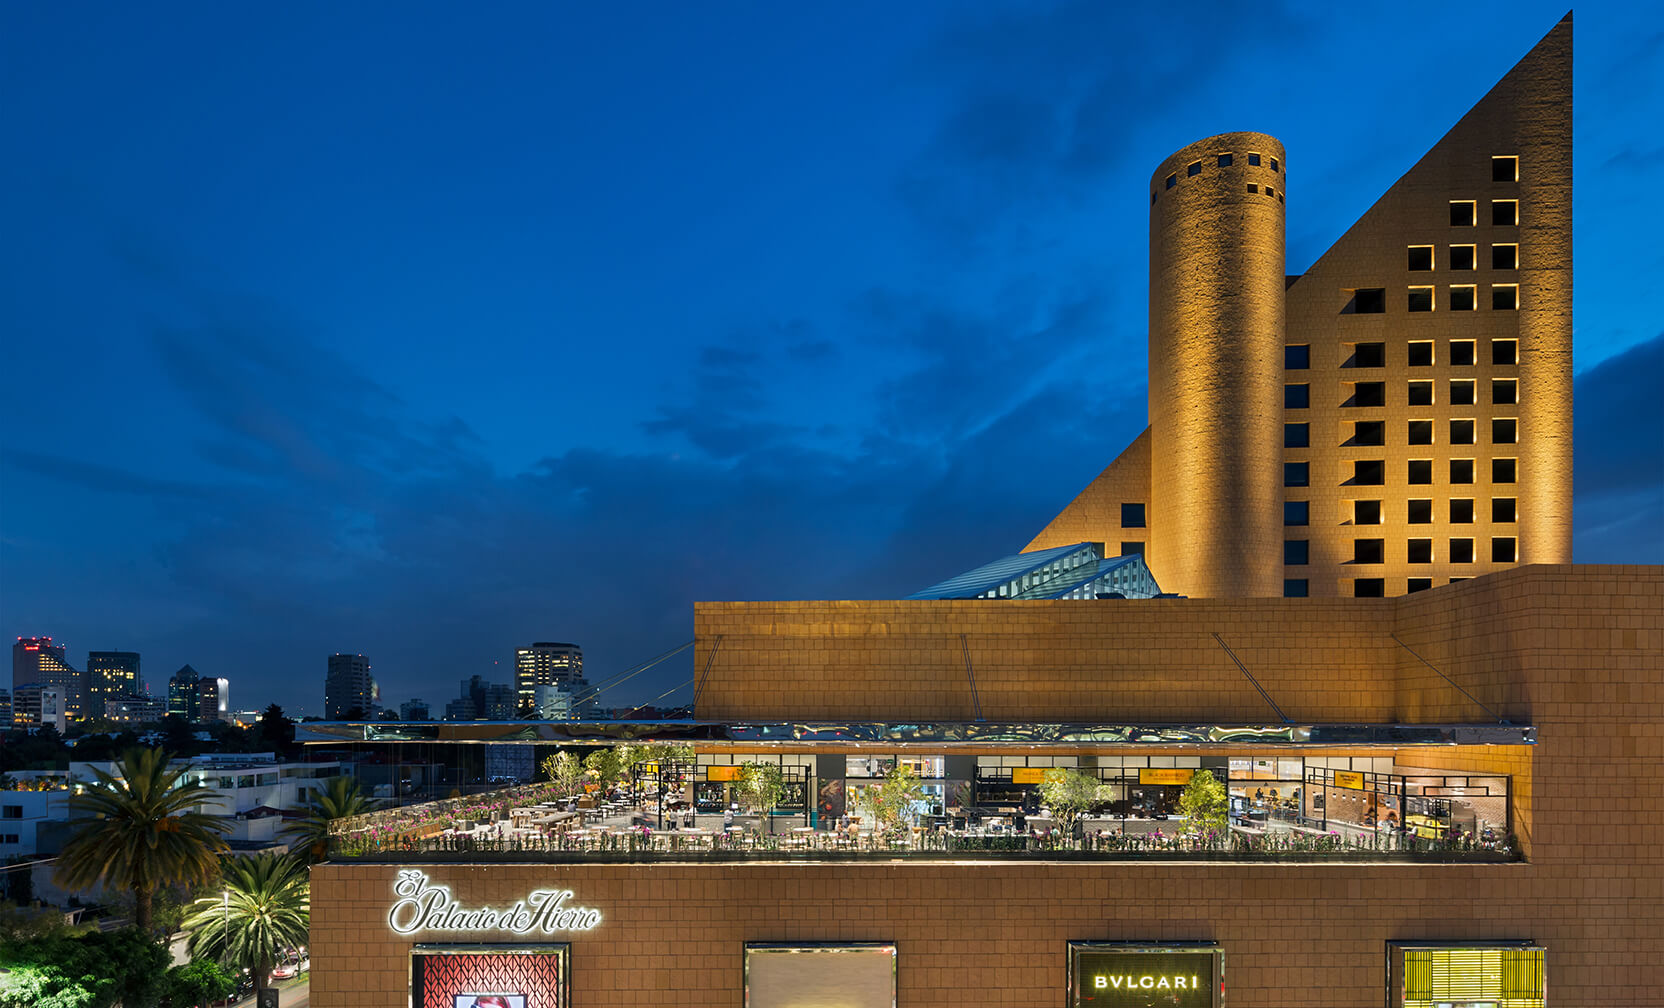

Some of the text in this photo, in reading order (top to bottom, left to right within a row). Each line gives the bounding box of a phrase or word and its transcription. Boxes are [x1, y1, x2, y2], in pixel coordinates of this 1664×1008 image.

[395, 871, 426, 897] El
[389, 887, 600, 934] Palacio de Hierro
[1095, 975, 1198, 989] BVLGARI
